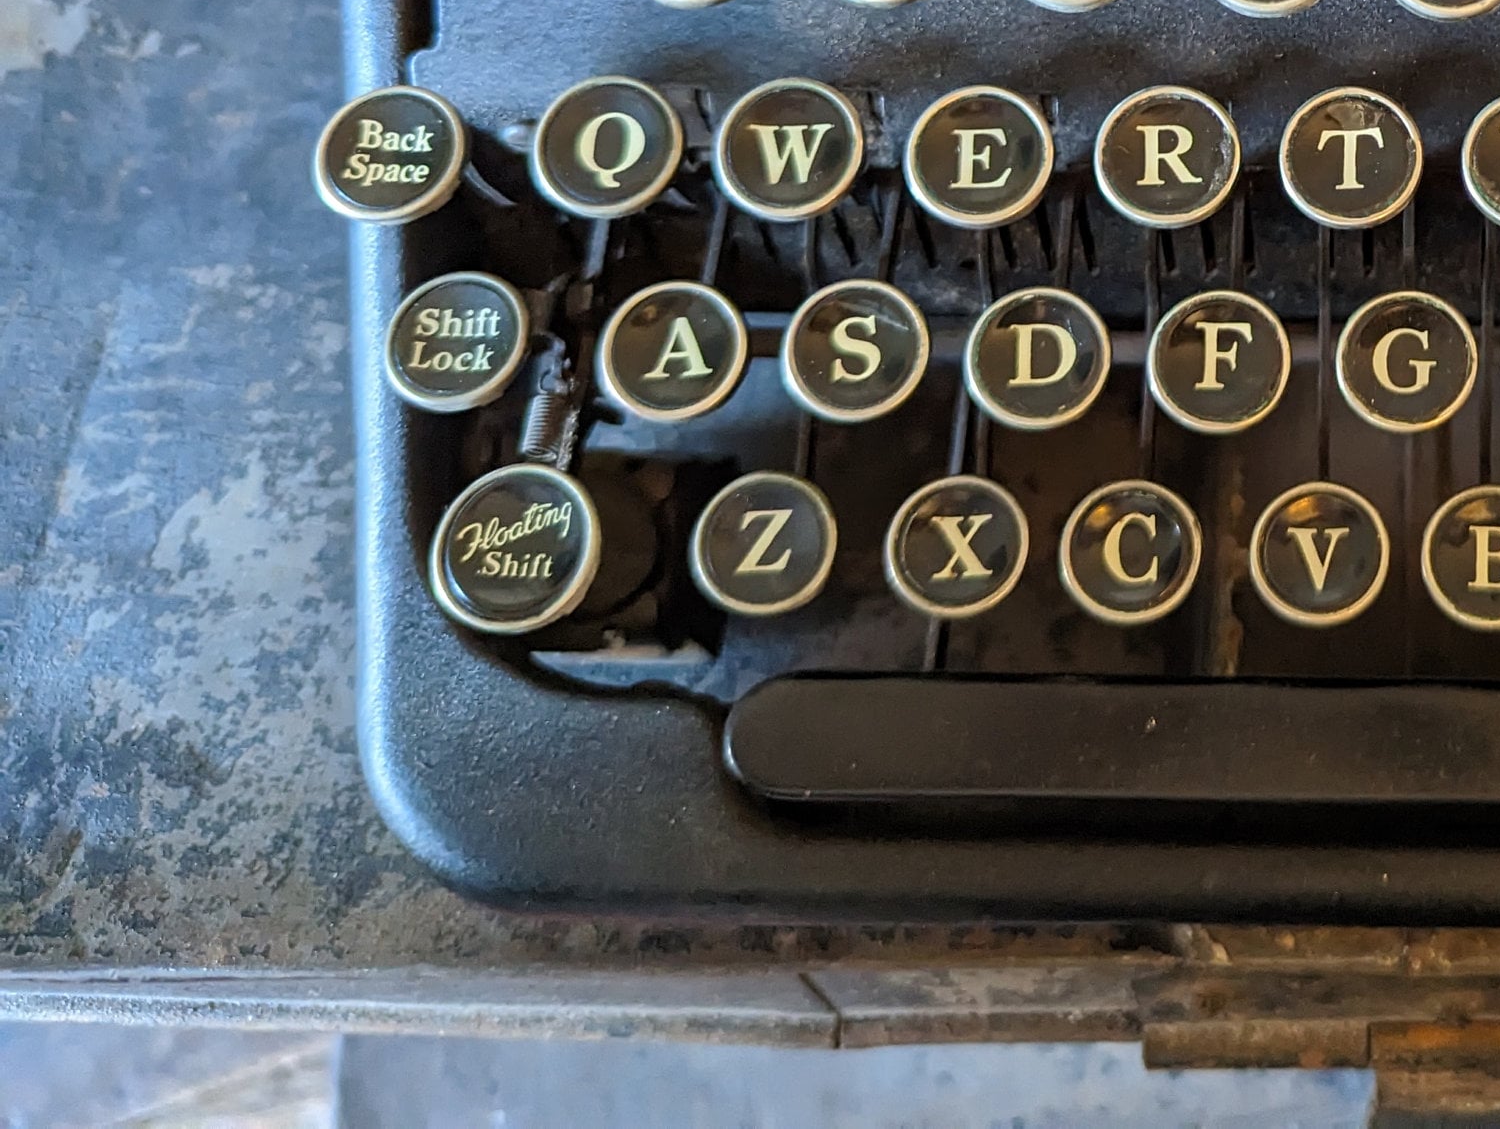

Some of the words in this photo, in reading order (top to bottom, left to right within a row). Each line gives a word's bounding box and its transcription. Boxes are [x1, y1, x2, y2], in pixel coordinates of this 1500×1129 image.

[357, 118, 435, 153] Back
[576, 111, 647, 188] Q
[750, 123, 835, 185] W
[949, 128, 1012, 189] E
[1135, 124, 1204, 186] R
[1317, 127, 1385, 190] T
[342, 152, 431, 187] Space
[415, 307, 502, 339] Shift
[643, 316, 714, 380] A
[831, 314, 882, 383] S
[408, 342, 495, 373] Lock
[1008, 323, 1079, 388] D
[1194, 321, 1254, 392] F
[1372, 328, 1438, 396] G
[459, 500, 573, 562] Floating
[735, 508, 794, 572] Z
[930, 513, 994, 580] X
[1103, 512, 1159, 584] C
[1287, 526, 1350, 592] V
[481, 551, 555, 579] Shift
